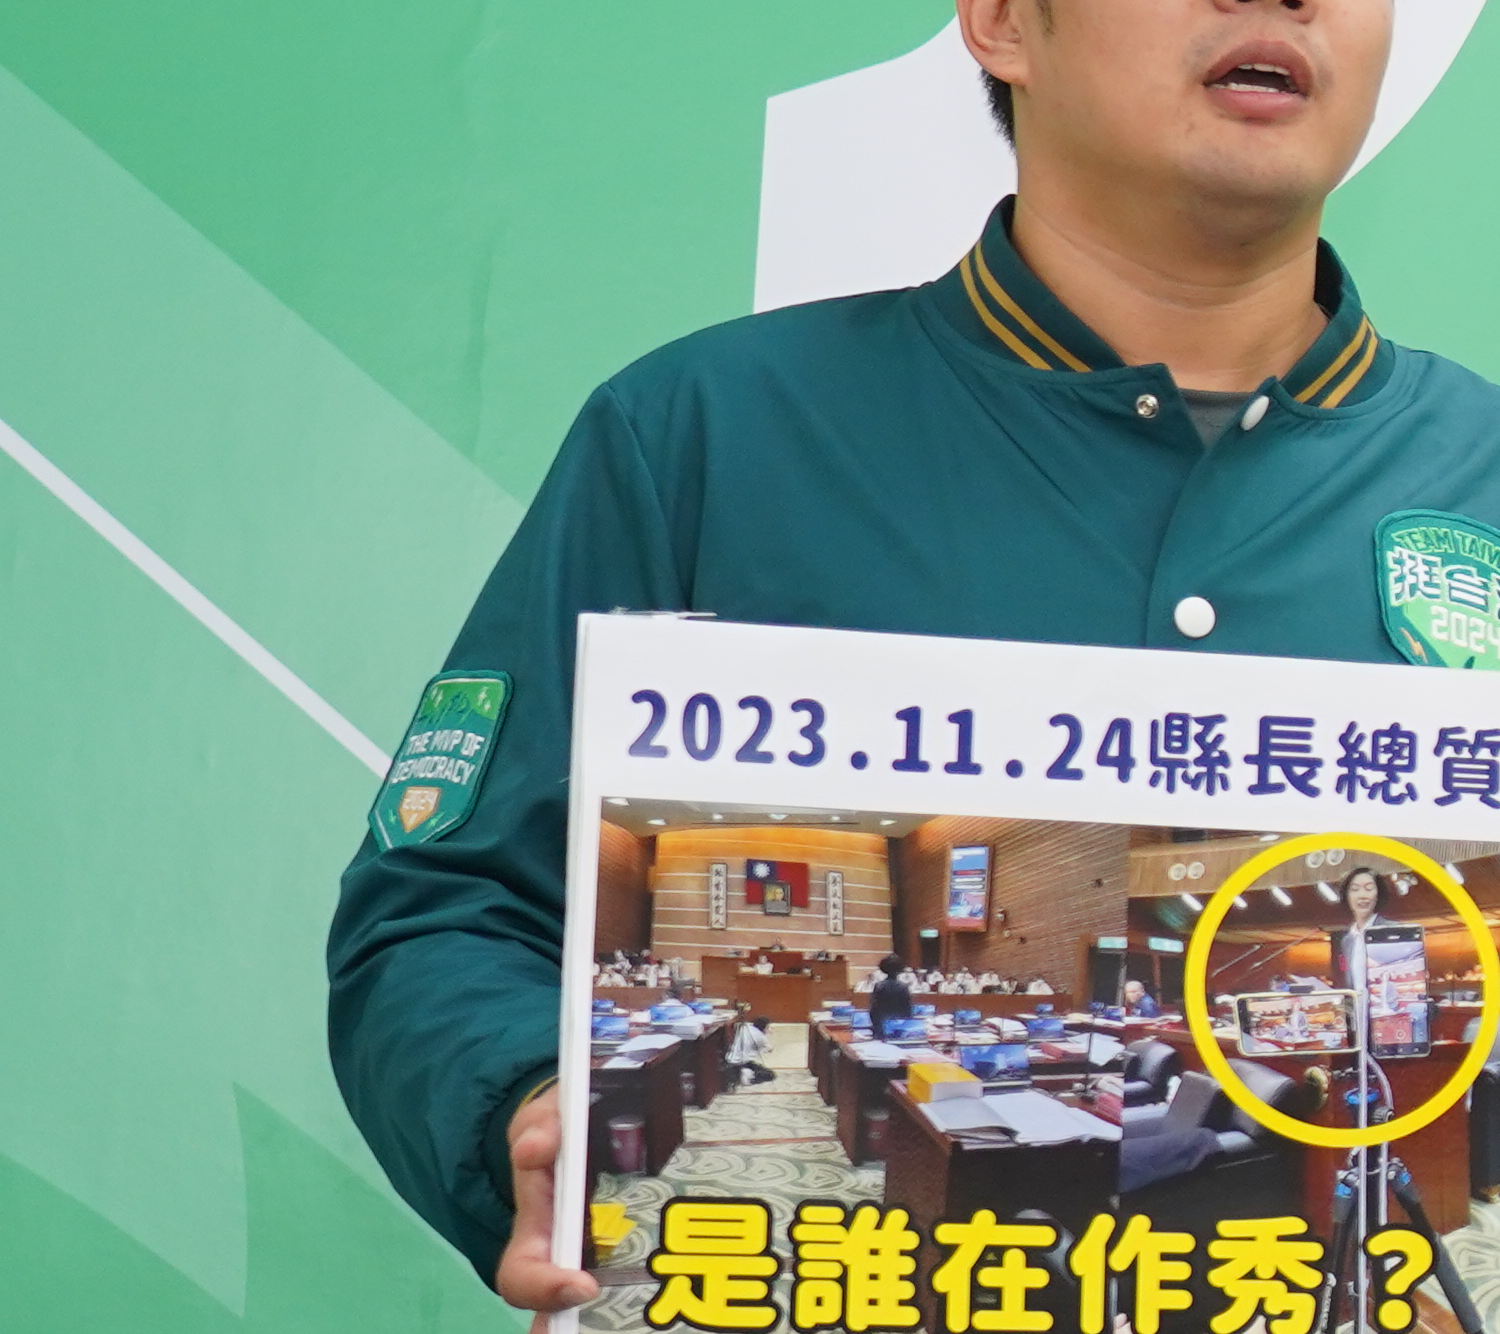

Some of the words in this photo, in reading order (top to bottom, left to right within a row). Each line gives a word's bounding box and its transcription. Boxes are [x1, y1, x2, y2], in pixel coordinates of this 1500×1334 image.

[1391, 527, 1455, 554] TEAM
[406, 731, 434, 755] THE
[430, 729, 464, 753] MVP
[460, 732, 486, 758] OF
[391, 755, 477, 785] DEMOCRACY
